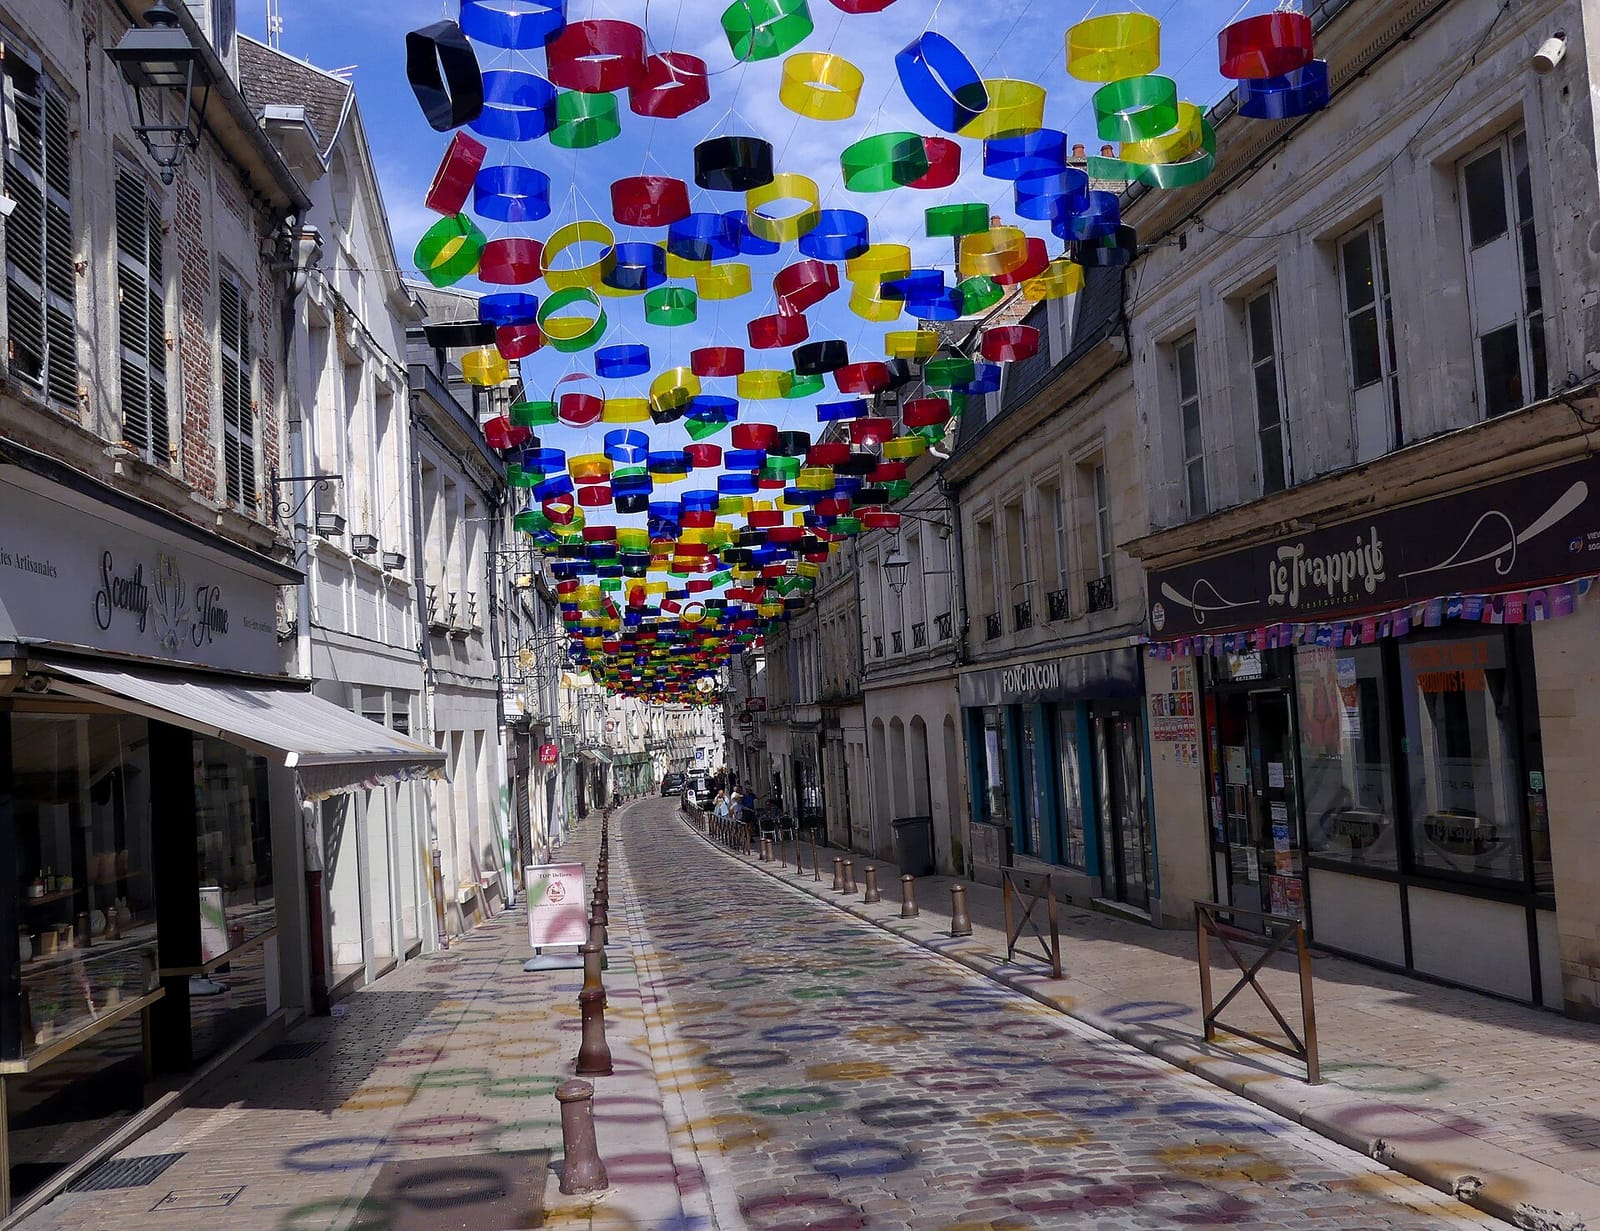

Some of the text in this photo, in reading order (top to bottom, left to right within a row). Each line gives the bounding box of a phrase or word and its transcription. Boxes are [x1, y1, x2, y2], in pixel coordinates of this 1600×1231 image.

[0, 547, 57, 578] ies Artisanales
[192, 585, 229, 647] Home
